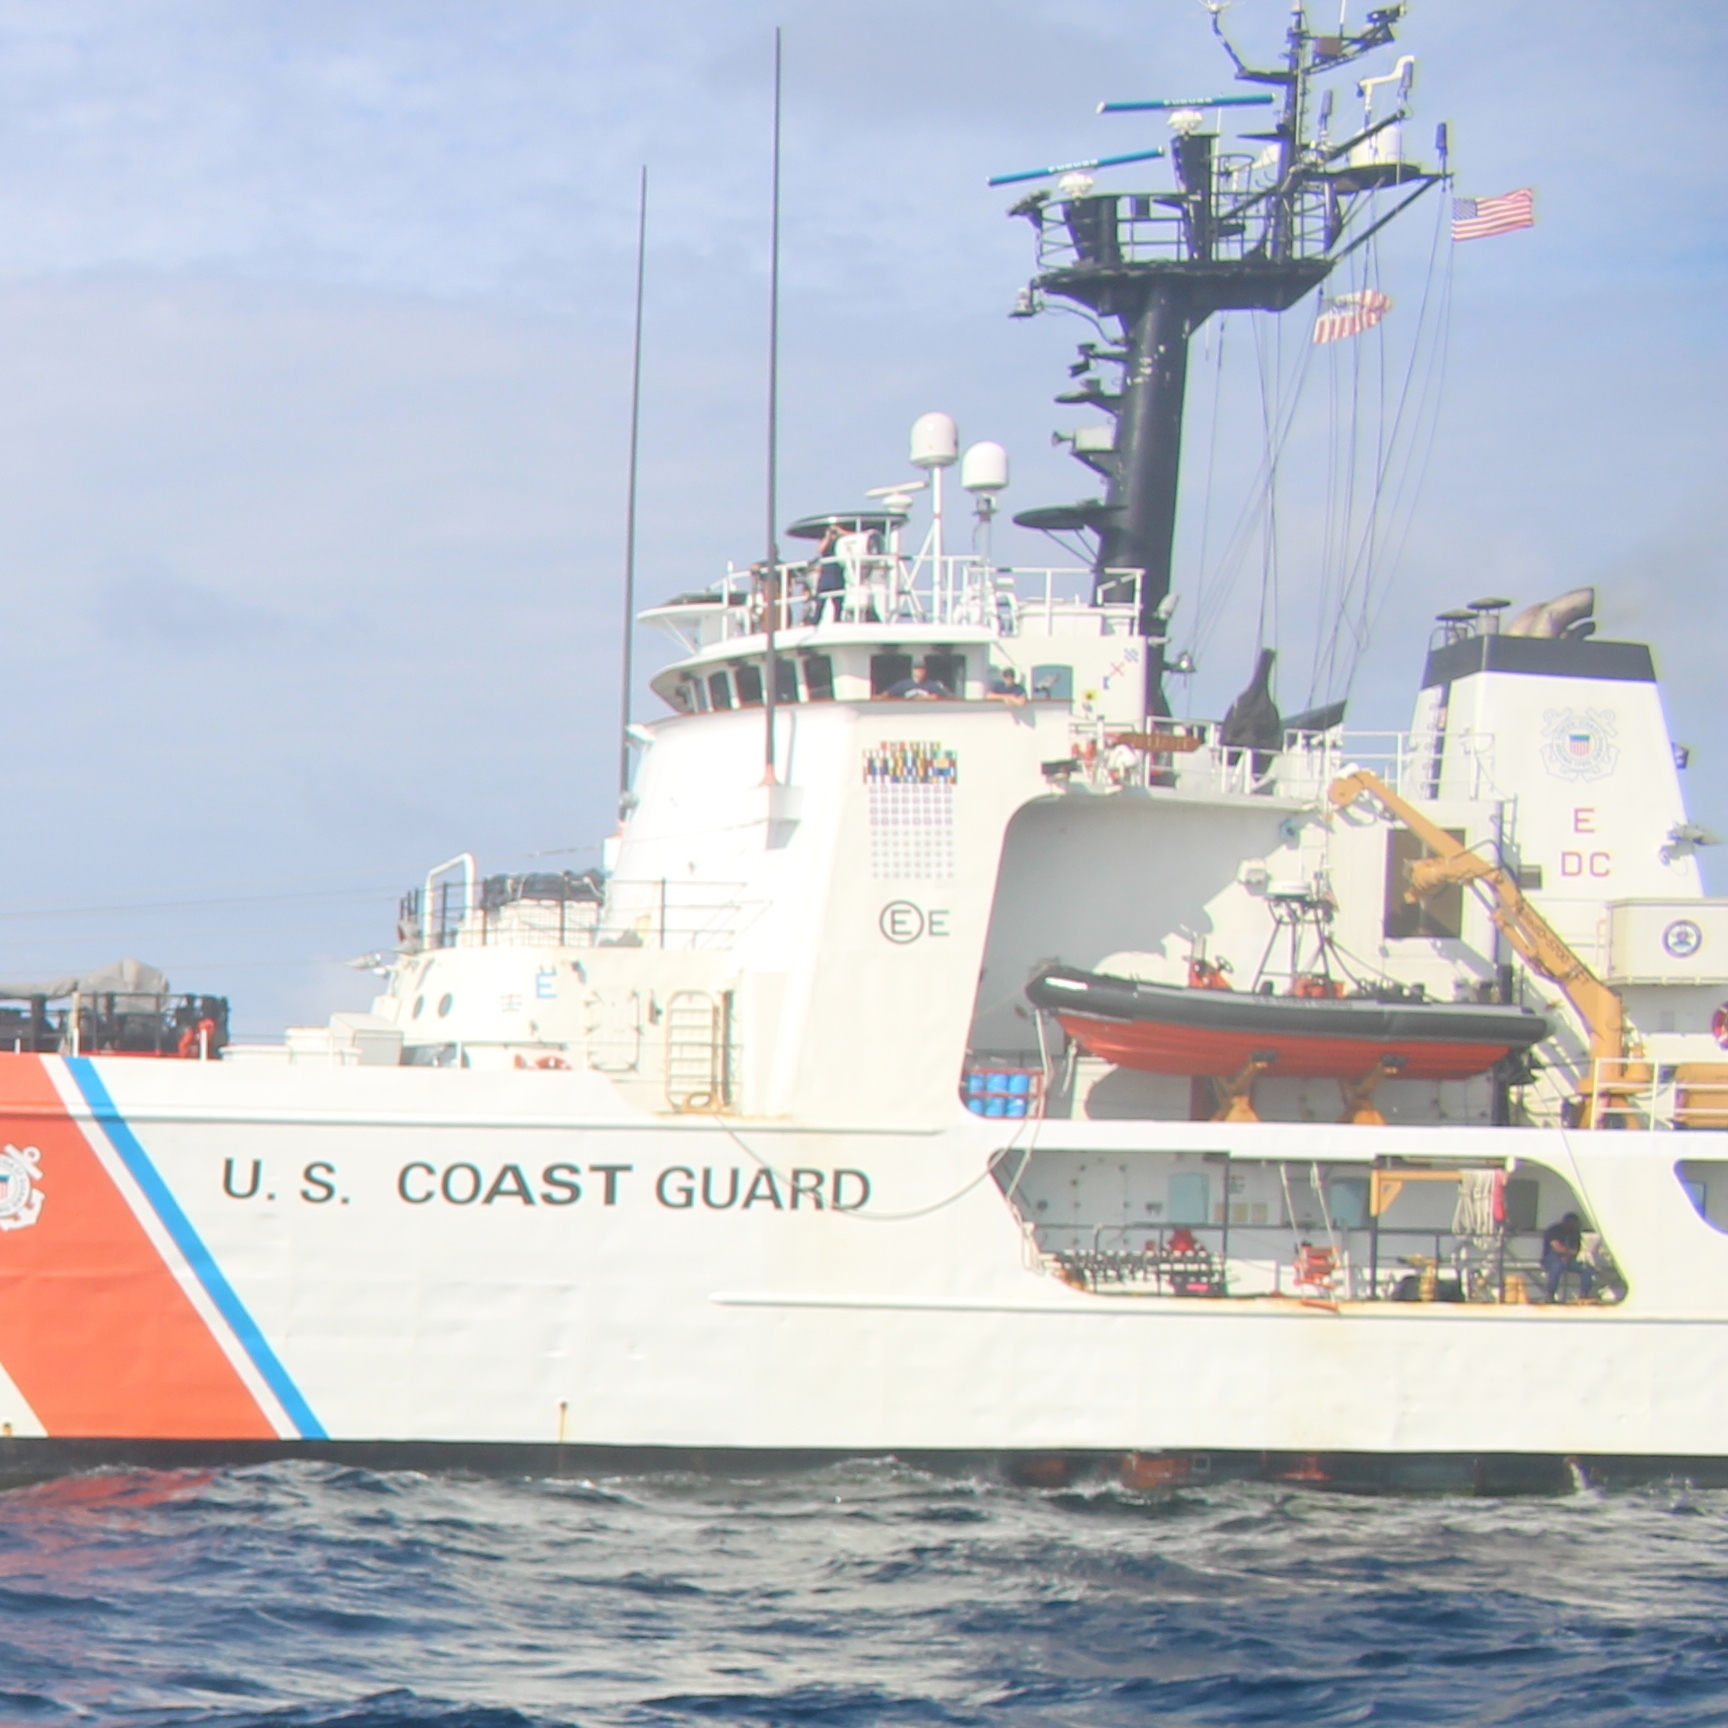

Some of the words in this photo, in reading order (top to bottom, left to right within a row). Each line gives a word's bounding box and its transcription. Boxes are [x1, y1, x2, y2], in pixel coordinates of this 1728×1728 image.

[1573, 808, 1595, 833] E
[1561, 851, 1610, 877] DC
[396, 1161, 634, 1207] COAST
[655, 1165, 872, 1212] GUARD
